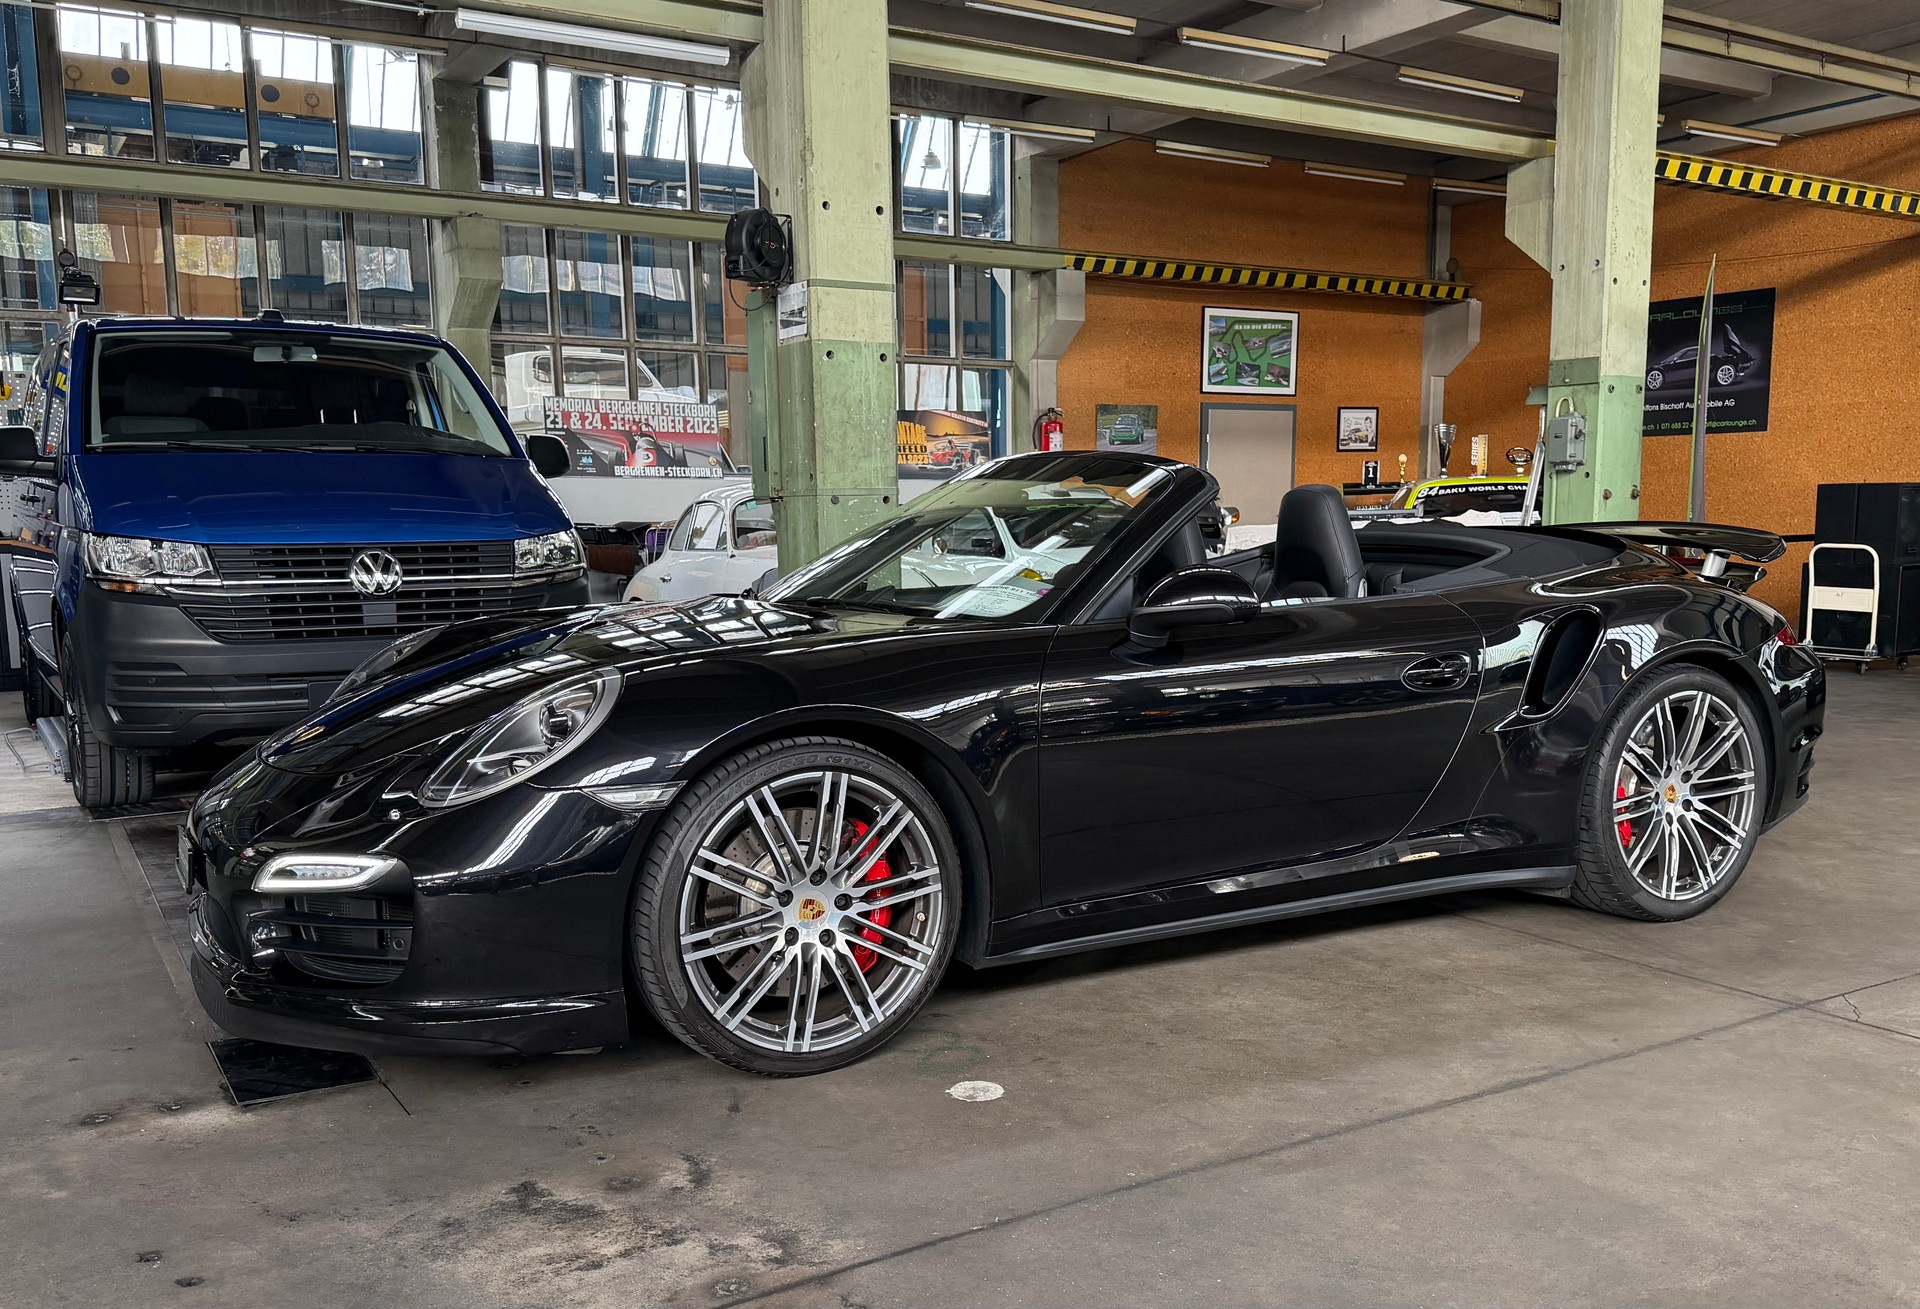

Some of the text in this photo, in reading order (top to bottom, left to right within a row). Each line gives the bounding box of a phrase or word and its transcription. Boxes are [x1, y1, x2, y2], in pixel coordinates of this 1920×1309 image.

[545, 397, 717, 418] MEMORIAL BERGRENNEN STECKBORN
[1660, 402, 1684, 410] Bischoff
[1724, 399, 1735, 407] AG
[546, 411, 568, 429] 23.
[570, 412, 582, 430] &
[584, 412, 607, 430] 24.
[686, 417, 718, 434] 2023
[614, 465, 723, 478] BERGRENNEN-STECKBORN.CH
[1368, 467, 1374, 478] 1
[1417, 486, 1439, 498] 84
[1438, 487, 1465, 496] BAKU
